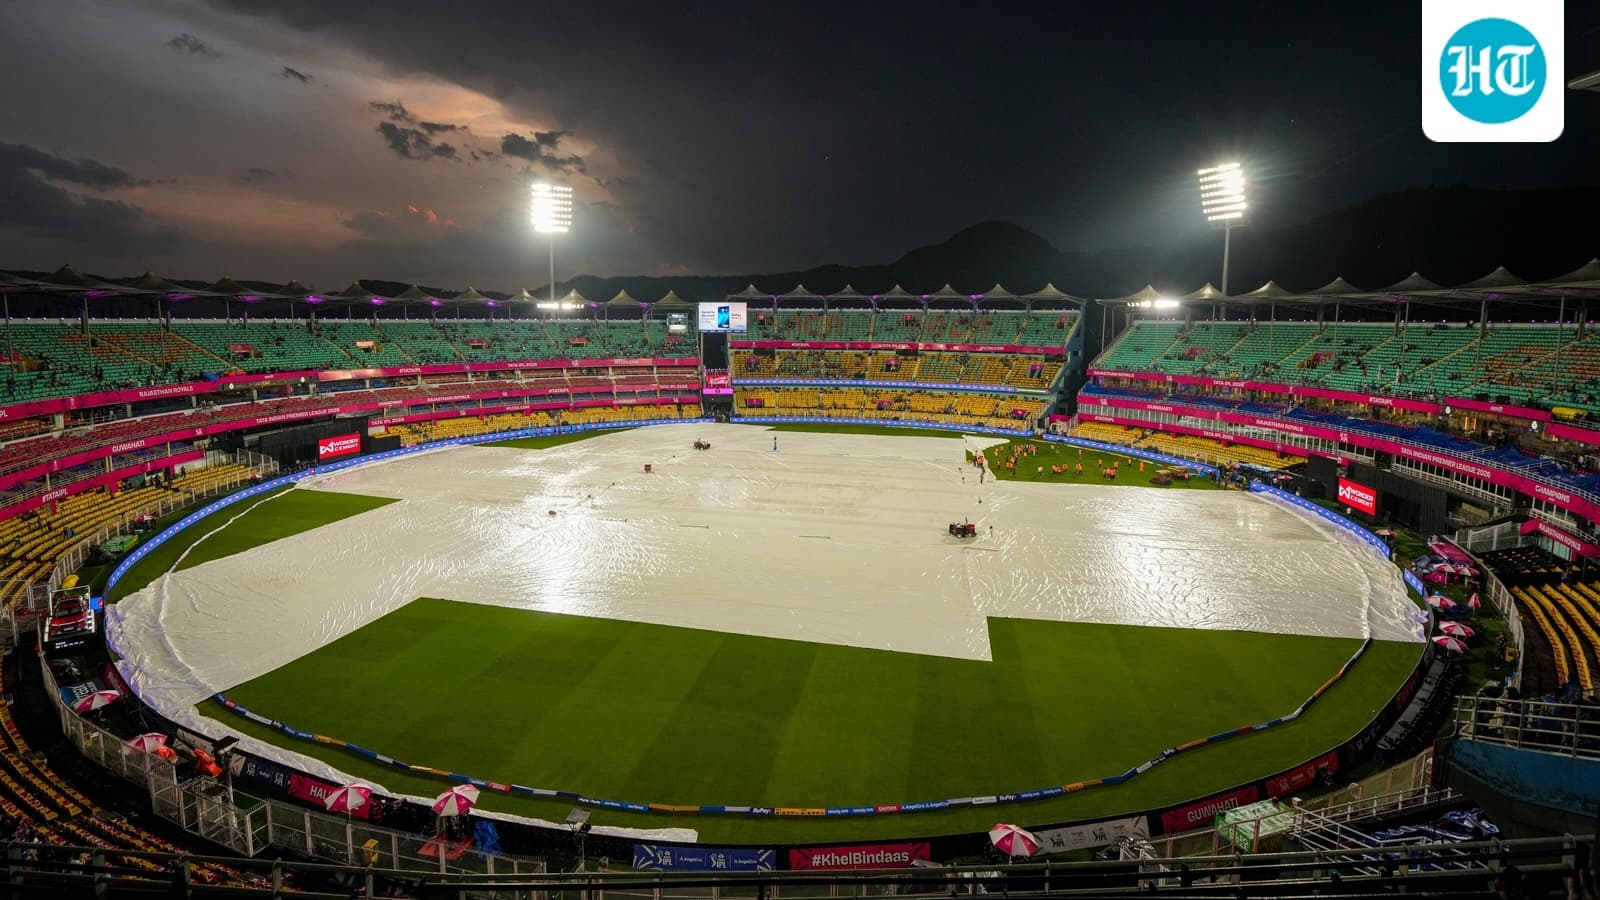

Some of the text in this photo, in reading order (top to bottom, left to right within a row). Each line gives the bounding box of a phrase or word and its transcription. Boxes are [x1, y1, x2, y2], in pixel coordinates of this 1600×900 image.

[139, 386, 194, 398] RAJASTHAN ROYALS
[1368, 397, 1393, 406] #TATAIPL
[286, 411, 308, 420] PREMIER
[308, 409, 327, 417] LEAGUE
[1256, 419, 1304, 432] RAJASTHAN ROYALS
[112, 440, 145, 453] GUWAHATI
[333, 438, 358, 446] WONDER
[334, 444, 358, 452] CEMENT
[1401, 448, 1491, 478] TATA INDIAN PREMIER LEAGUE 2026
[42, 488, 68, 503] #TATAIPL
[1350, 488, 1374, 502] WONDER
[1350, 494, 1373, 508] CEMENT
[1535, 484, 1570, 504] CHAMPIONS
[1538, 523, 1582, 551] RAJASTHAN ROYALS
[1186, 797, 1239, 823] GUWAHATI
[812, 850, 910, 866] #KhelBindaas
